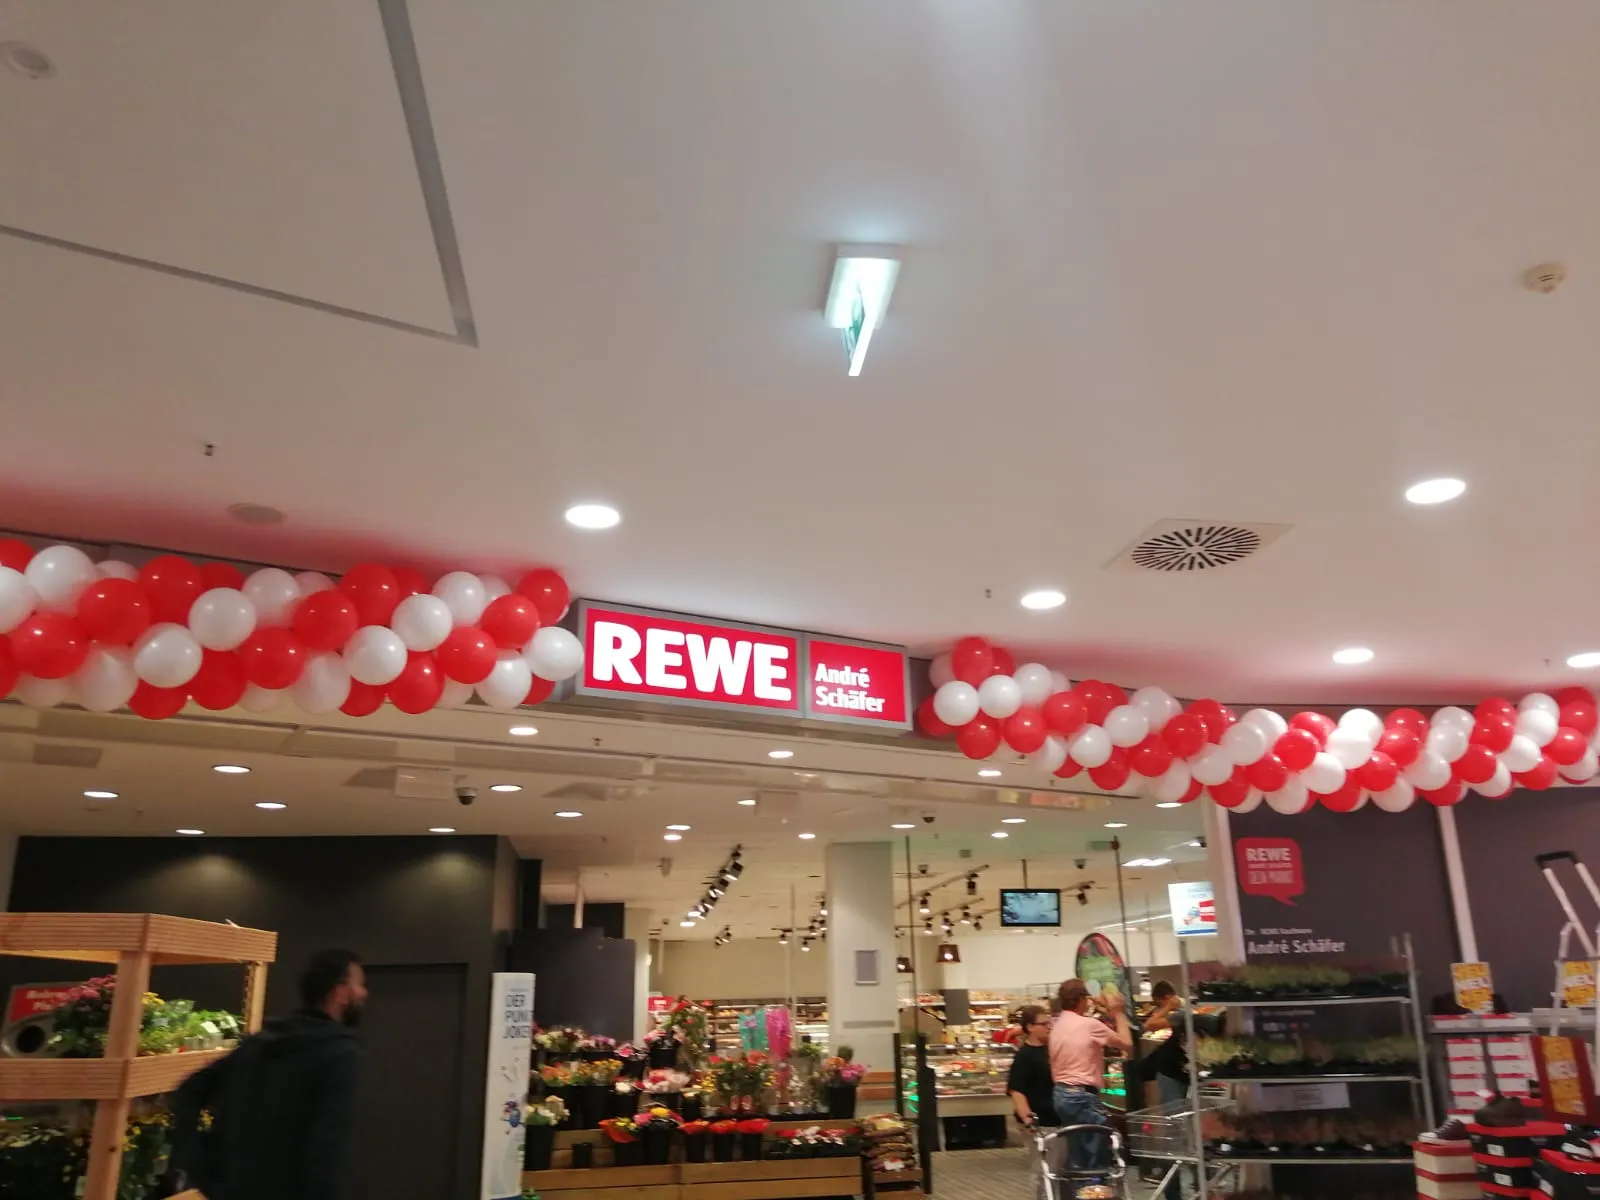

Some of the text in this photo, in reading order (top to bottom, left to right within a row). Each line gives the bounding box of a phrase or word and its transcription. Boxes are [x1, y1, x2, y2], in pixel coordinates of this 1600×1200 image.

[592, 620, 792, 701] REWE
[815, 662, 870, 688] André
[815, 685, 886, 713] Schäfer
[1245, 847, 1292, 862] REWE
[1246, 938, 1347, 955] André Schäfer
[504, 994, 526, 1008] DER
